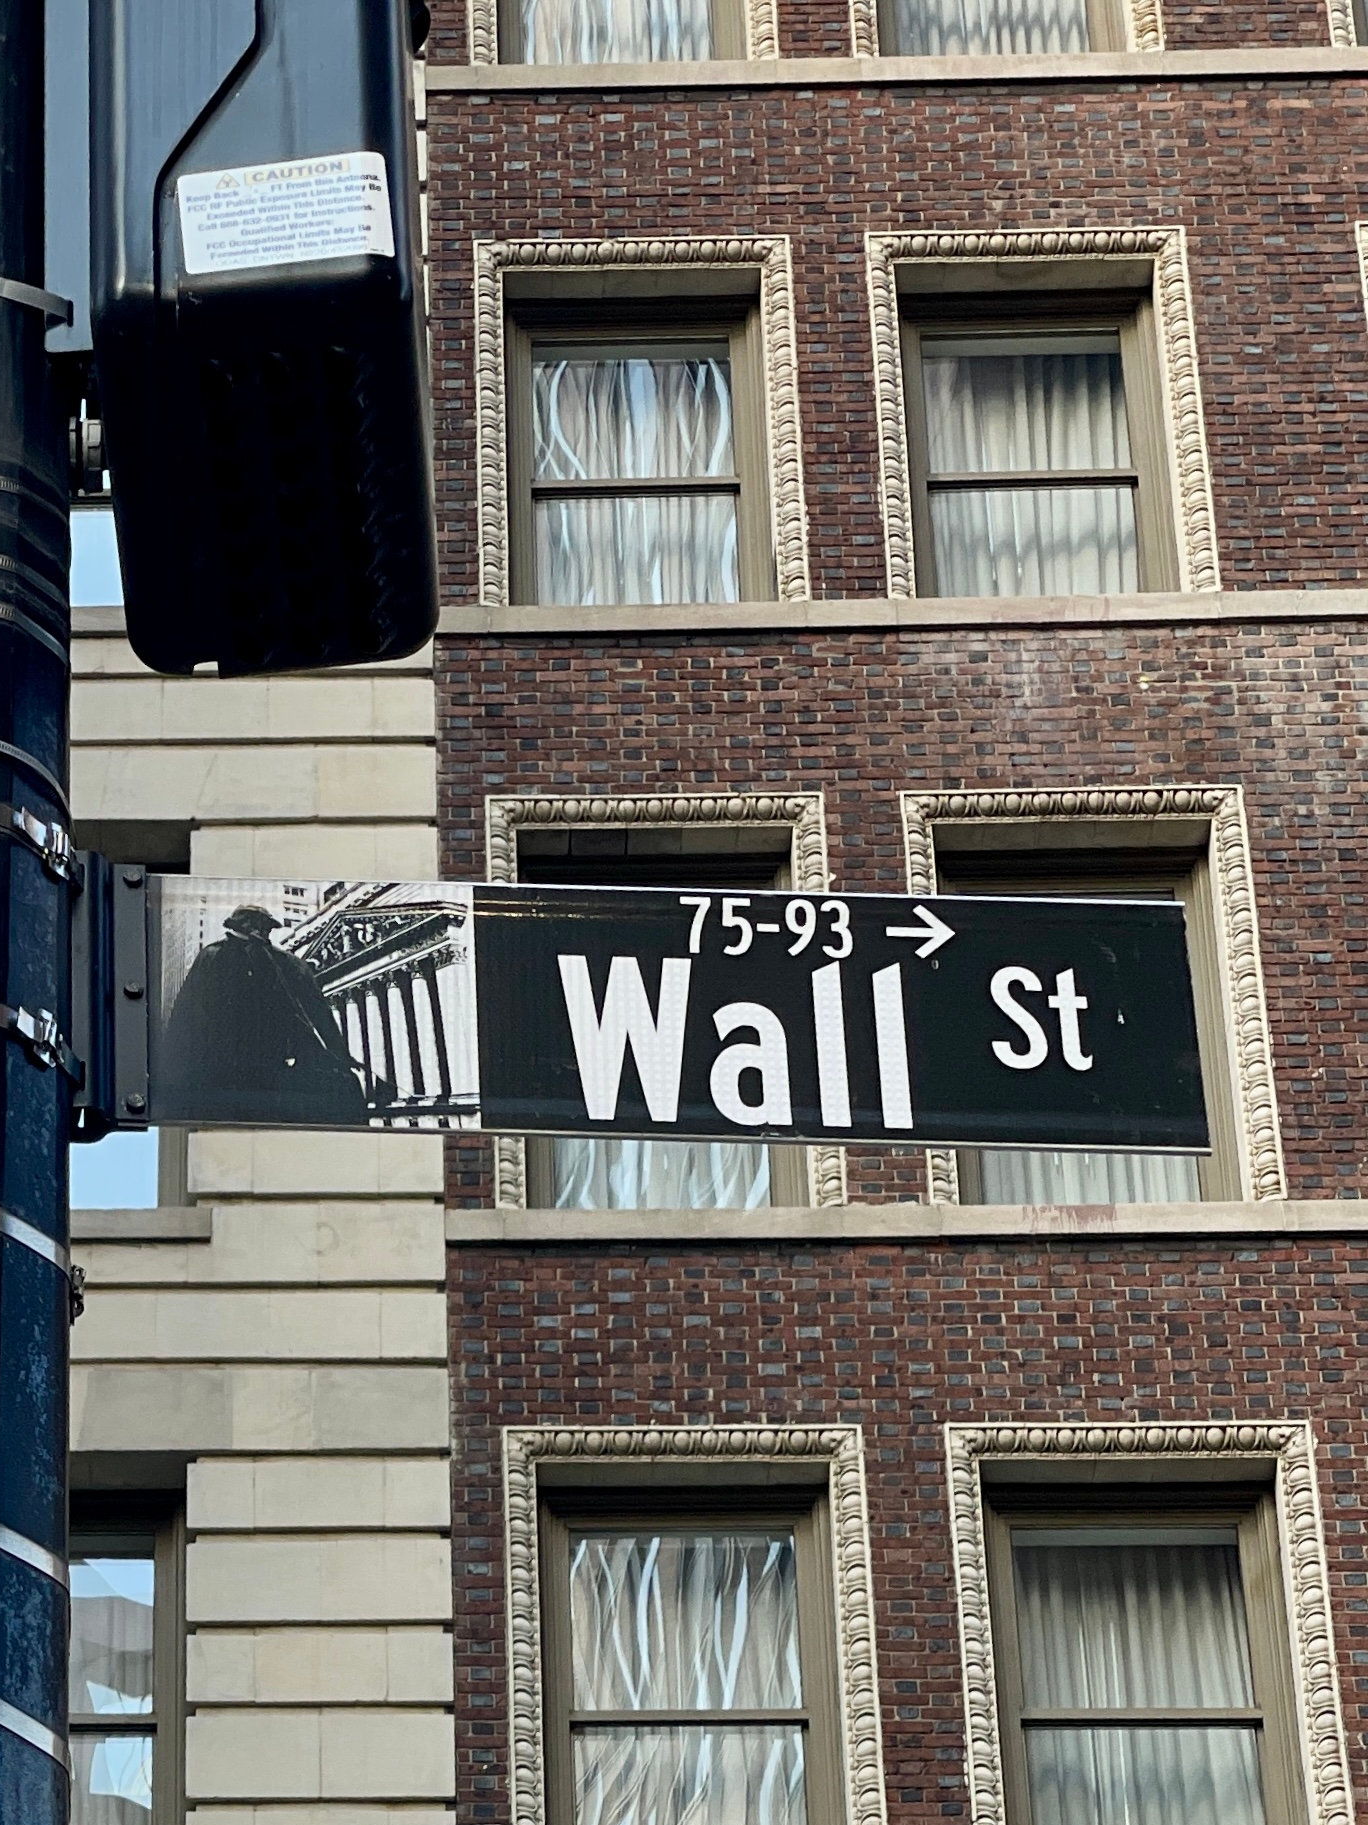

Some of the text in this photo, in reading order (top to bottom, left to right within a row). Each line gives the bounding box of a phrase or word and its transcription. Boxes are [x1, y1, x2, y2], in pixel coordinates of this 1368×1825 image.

[252, 161, 343, 182] CAUTION
[186, 194, 211, 204] Keep
[214, 190, 239, 200] Back
[271, 183, 283, 193] FT
[287, 181, 312, 191] From
[315, 177, 334, 187] this
[187, 203, 207, 213] FCC
[210, 202, 222, 211] RF
[226, 197, 257, 208] Public
[260, 190, 307, 203] Exposure
[311, 186, 342, 197] Limits
[344, 184, 366, 193] May
[198, 222, 218, 232] Call
[294, 211, 308, 220] for
[207, 207, 255, 220] Exceeded
[258, 203, 291, 214] Within
[206, 241, 226, 251] FCC
[229, 232, 296, 249] Occupational
[299, 228, 331, 240] Limits
[333, 226, 355, 236] May
[241, 223, 286, 237] Qualified
[679, 895, 854, 959] 75-93
[557, 954, 1093, 1129] Wall St
